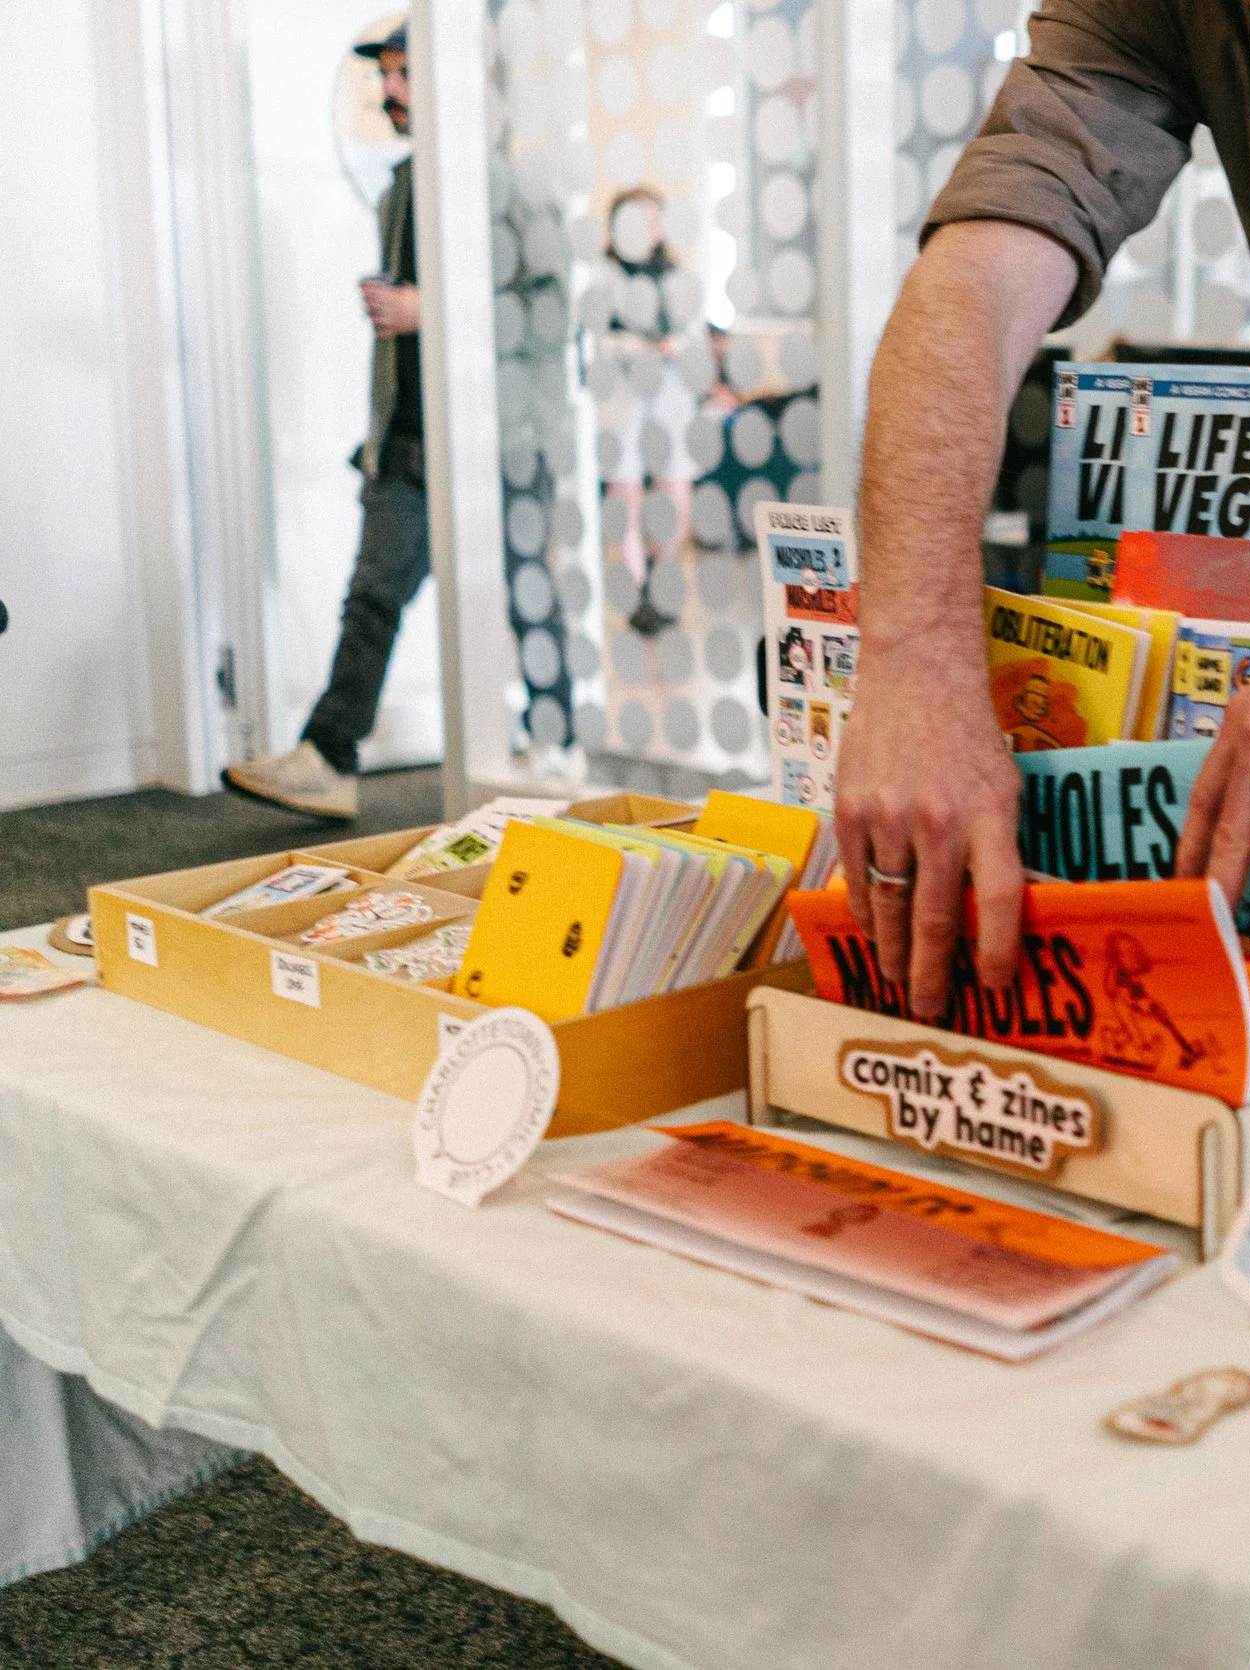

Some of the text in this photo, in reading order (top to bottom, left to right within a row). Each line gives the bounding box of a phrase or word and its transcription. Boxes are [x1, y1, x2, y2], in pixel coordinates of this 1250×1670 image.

[1081, 404, 1128, 460] LI
[990, 604, 1114, 676] OBLITERATION
[1020, 765, 1180, 882] HOLES
[853, 1057, 1086, 1138] comix & zines
[899, 1093, 1046, 1163] by hame
